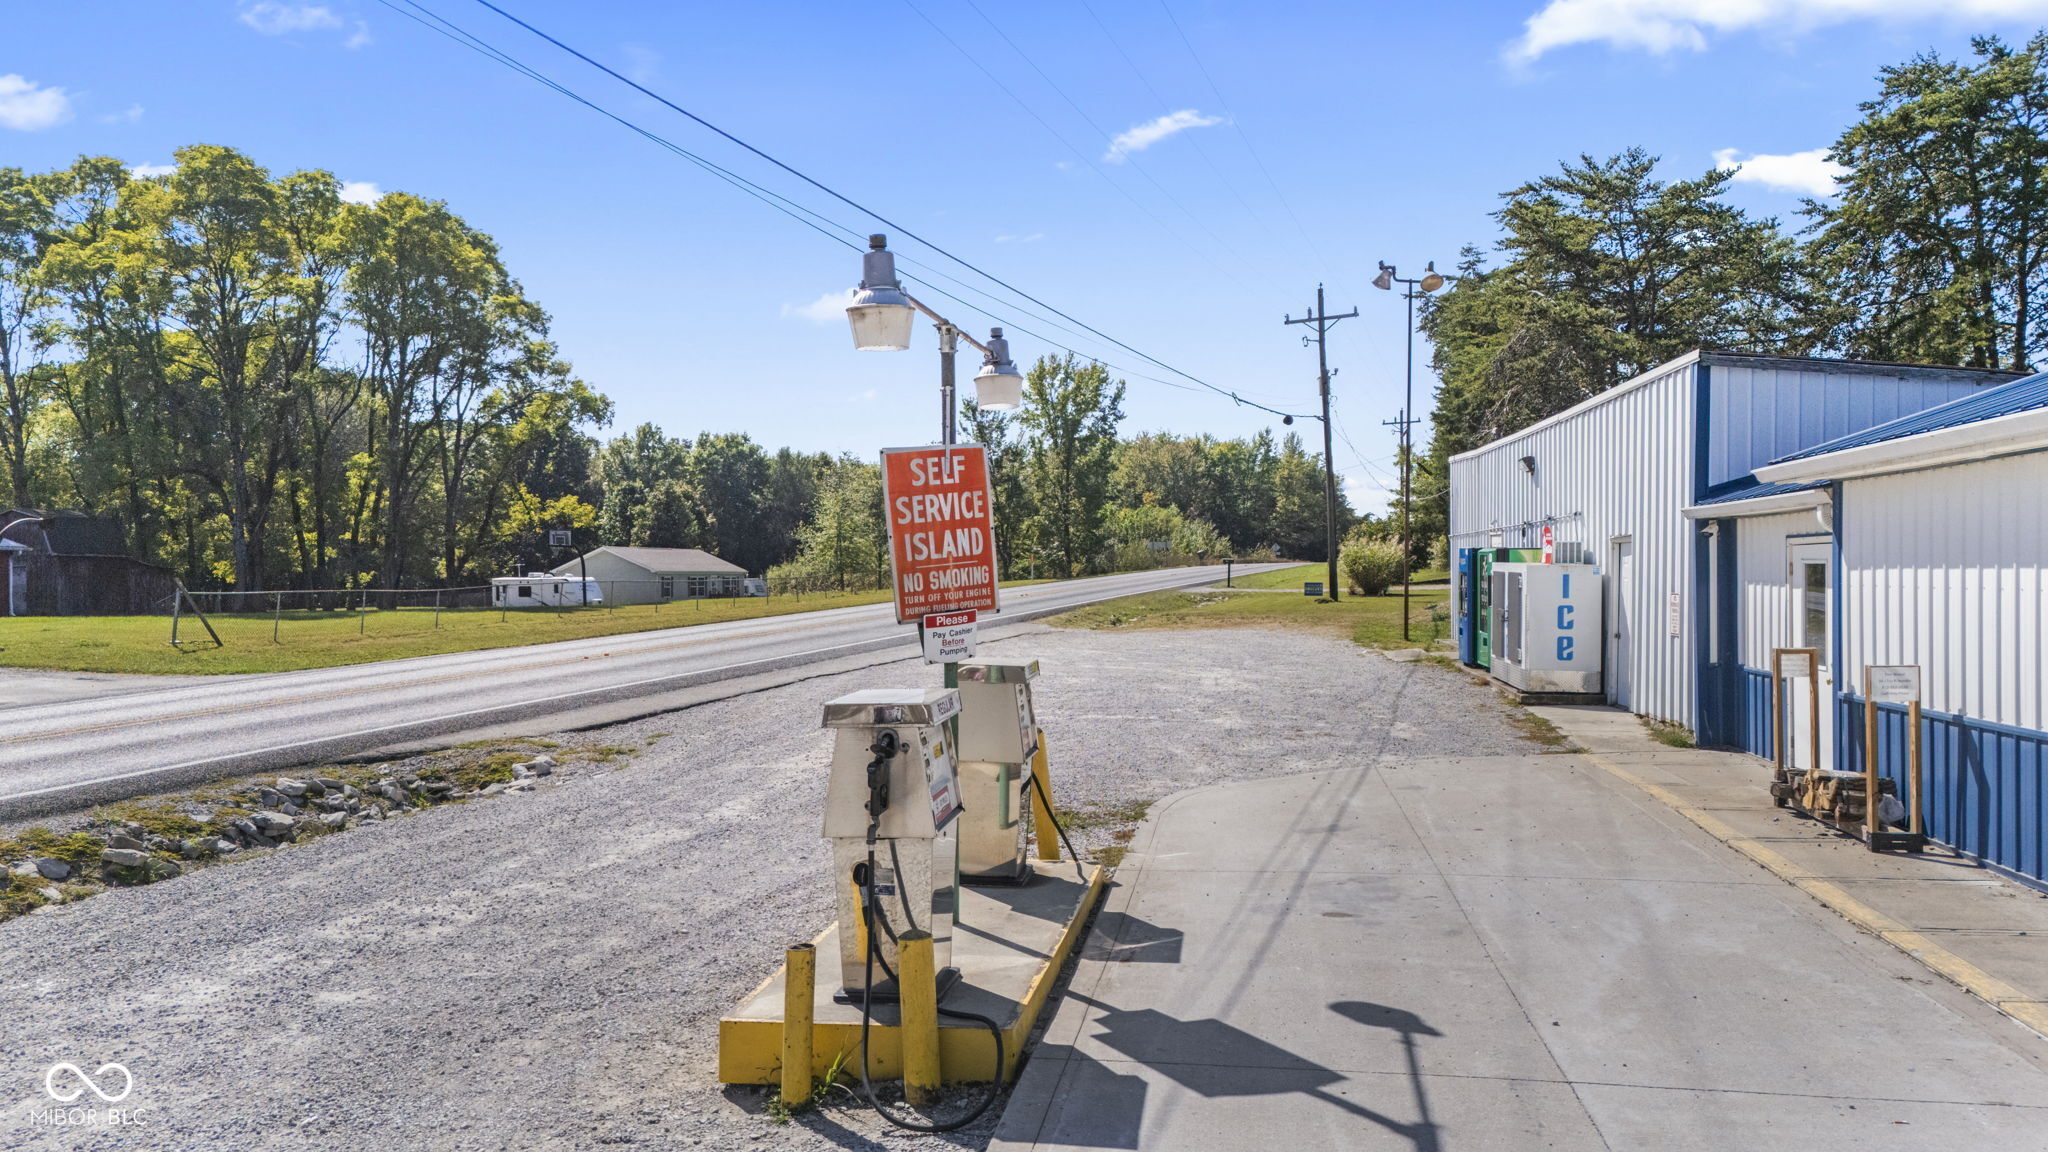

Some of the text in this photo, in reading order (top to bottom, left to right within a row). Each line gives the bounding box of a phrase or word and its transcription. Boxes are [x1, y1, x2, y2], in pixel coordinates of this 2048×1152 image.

[910, 455, 965, 487] SELF
[896, 491, 984, 525] SERVICE
[904, 527, 984, 562] ISLAND
[903, 565, 990, 593] NO SMOKING
[904, 587, 992, 604] TURN OFF YOUR ENGINE
[905, 598, 992, 616] DURING FUELING OPERATION
[936, 615, 969, 626] Please
[932, 627, 973, 639] Pay Cashier
[941, 638, 965, 646] Before
[940, 646, 968, 656] Pumping
